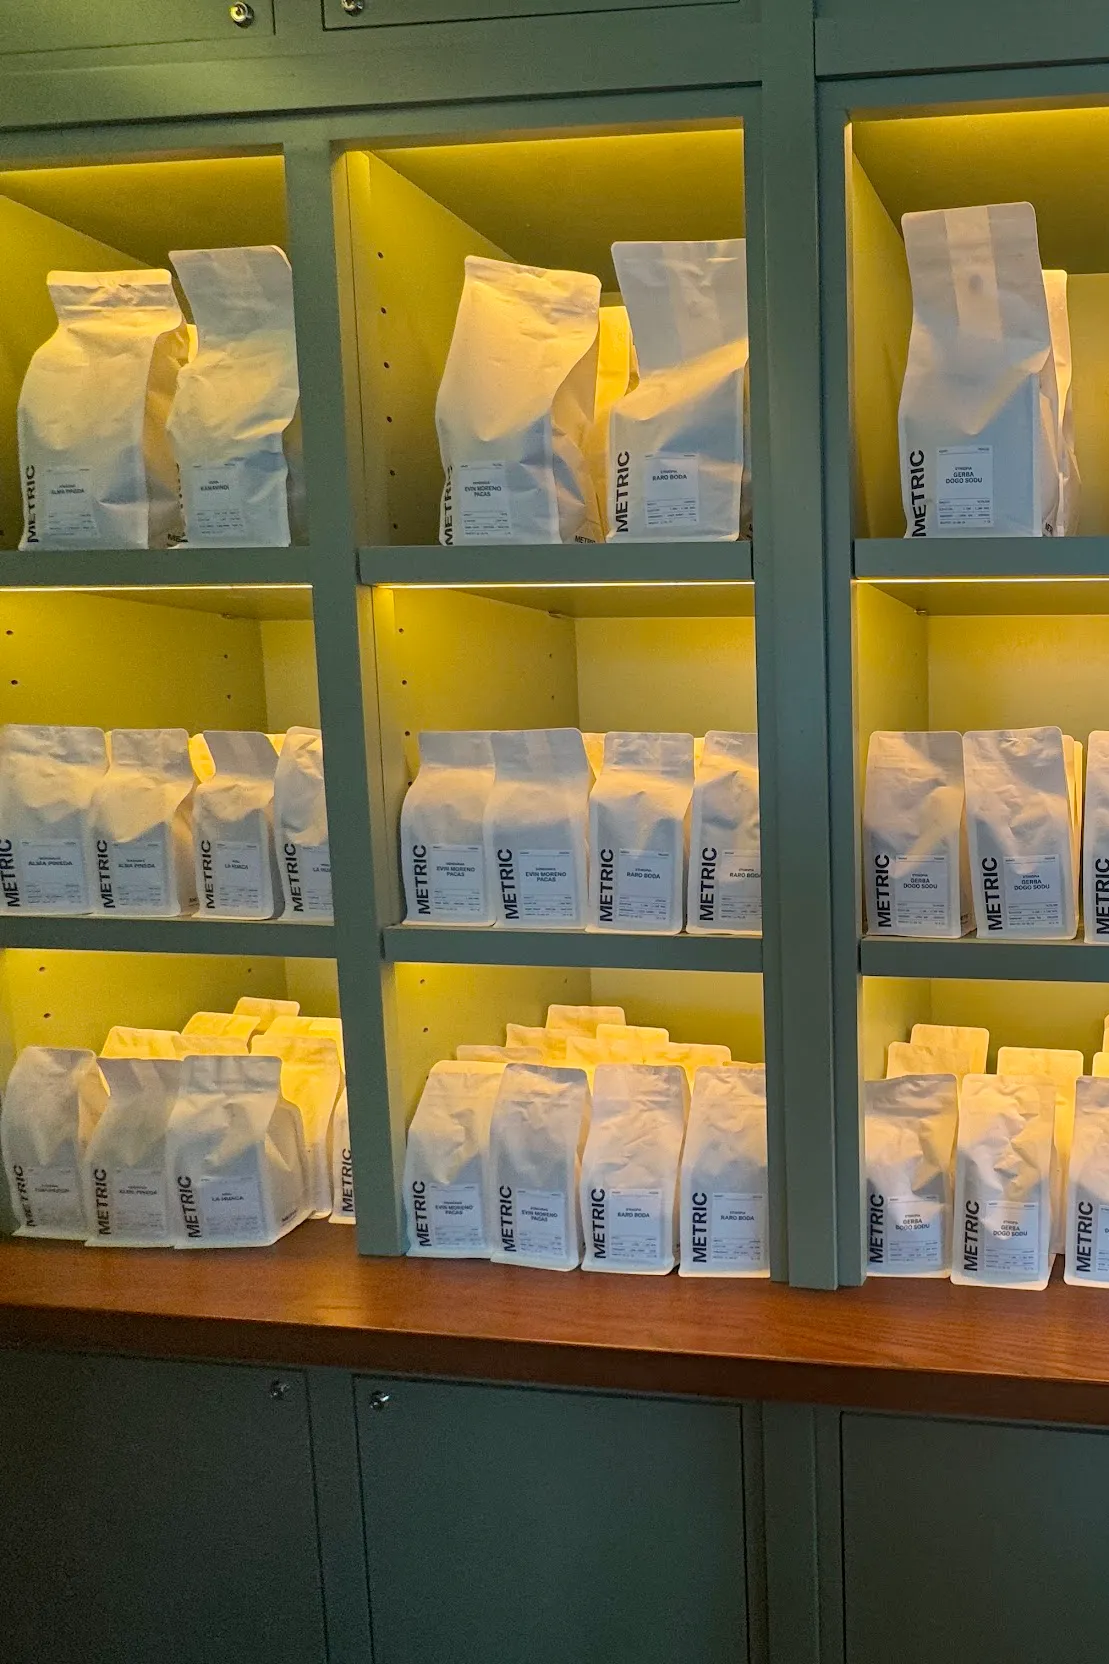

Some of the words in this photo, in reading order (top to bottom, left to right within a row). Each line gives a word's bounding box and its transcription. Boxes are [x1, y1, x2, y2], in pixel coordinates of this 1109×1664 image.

[26, 465, 39, 543] METRIC
[616, 451, 630, 533] METRIC
[910, 450, 927, 537] METRIC
[96, 840, 116, 908] METRIC
[201, 840, 215, 908] METRIC
[284, 843, 304, 912] METRIC
[413, 845, 431, 914] METRIC
[497, 848, 519, 919] METRIC
[600, 849, 614, 922] METRIC
[699, 847, 717, 920] METRIC
[875, 854, 892, 927] METRIC
[982, 857, 1003, 930] METRIC
[94, 1169, 111, 1235] METRIC
[177, 1176, 202, 1238] METRIC
[341, 1148, 354, 1212] METRIC
[412, 1181, 432, 1246] METRIC
[499, 1185, 517, 1252] METRIC
[591, 1189, 606, 1258] METRIC
[692, 1192, 707, 1263] METRIC
[869, 1194, 884, 1263] METRIC
[964, 1200, 980, 1271] METRIC
[1076, 1201, 1093, 1272] METRIC
